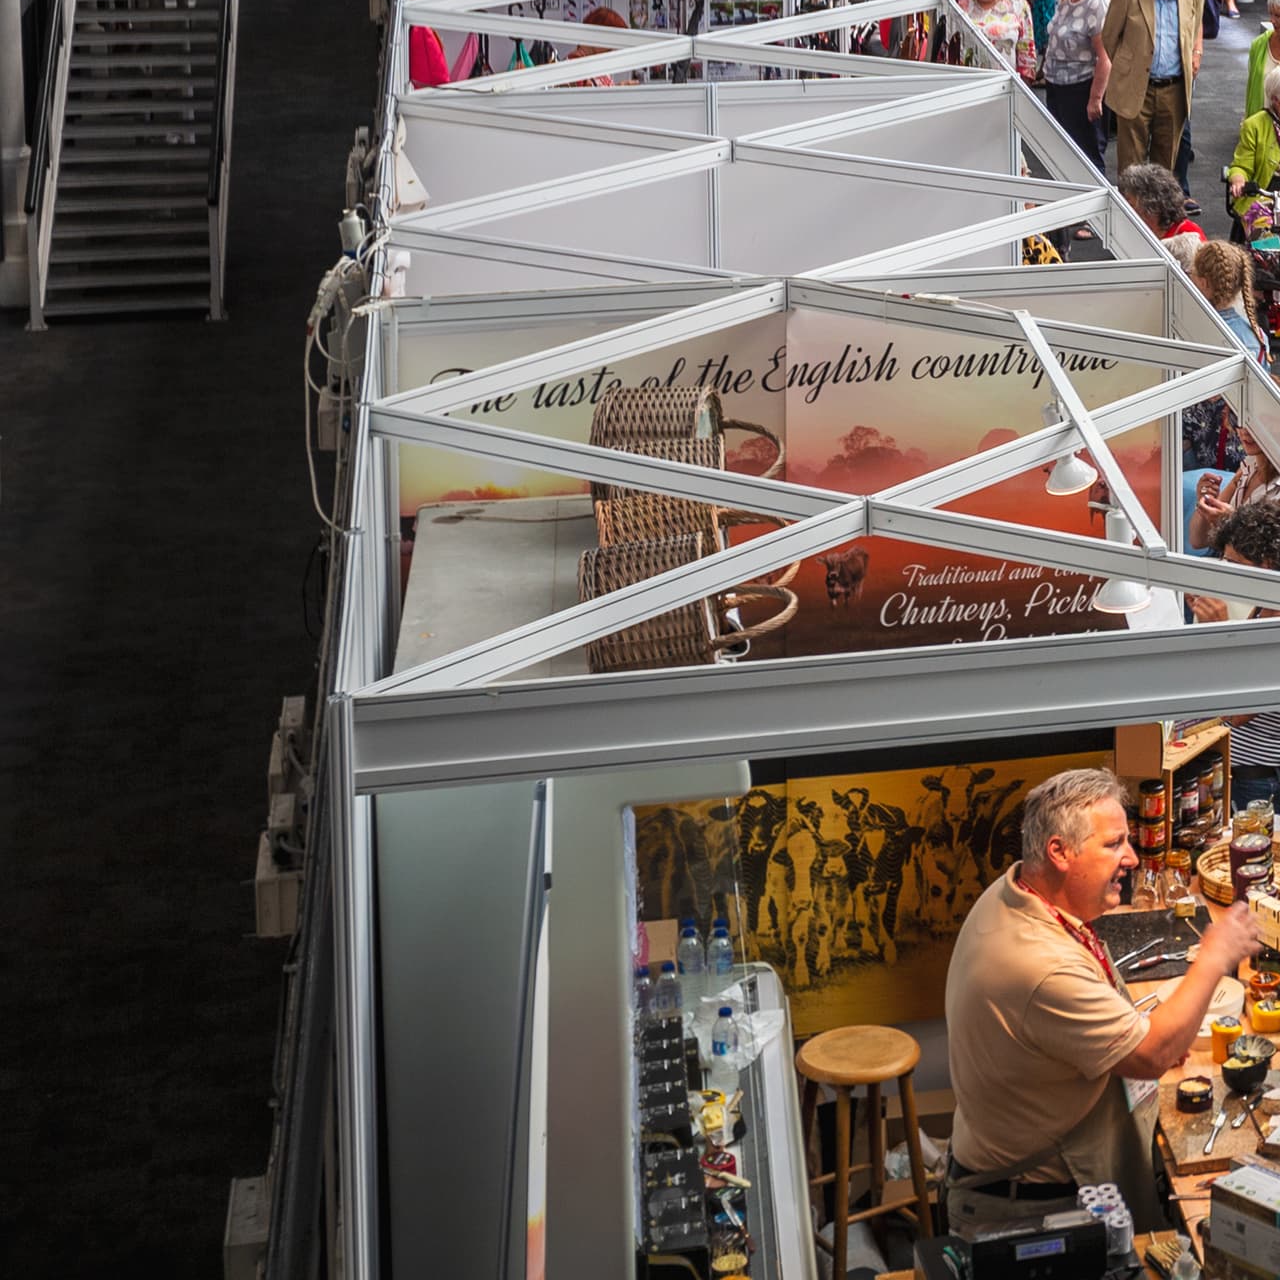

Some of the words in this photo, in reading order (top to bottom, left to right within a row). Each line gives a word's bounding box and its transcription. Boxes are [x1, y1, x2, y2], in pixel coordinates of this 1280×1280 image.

[696, 354, 756, 396] the
[760, 342, 903, 405] English
[902, 561, 1007, 588] Traditional
[1008, 565, 1044, 581] and
[879, 592, 1013, 632] Chutneys,
[1023, 581, 1103, 618] Pickl
